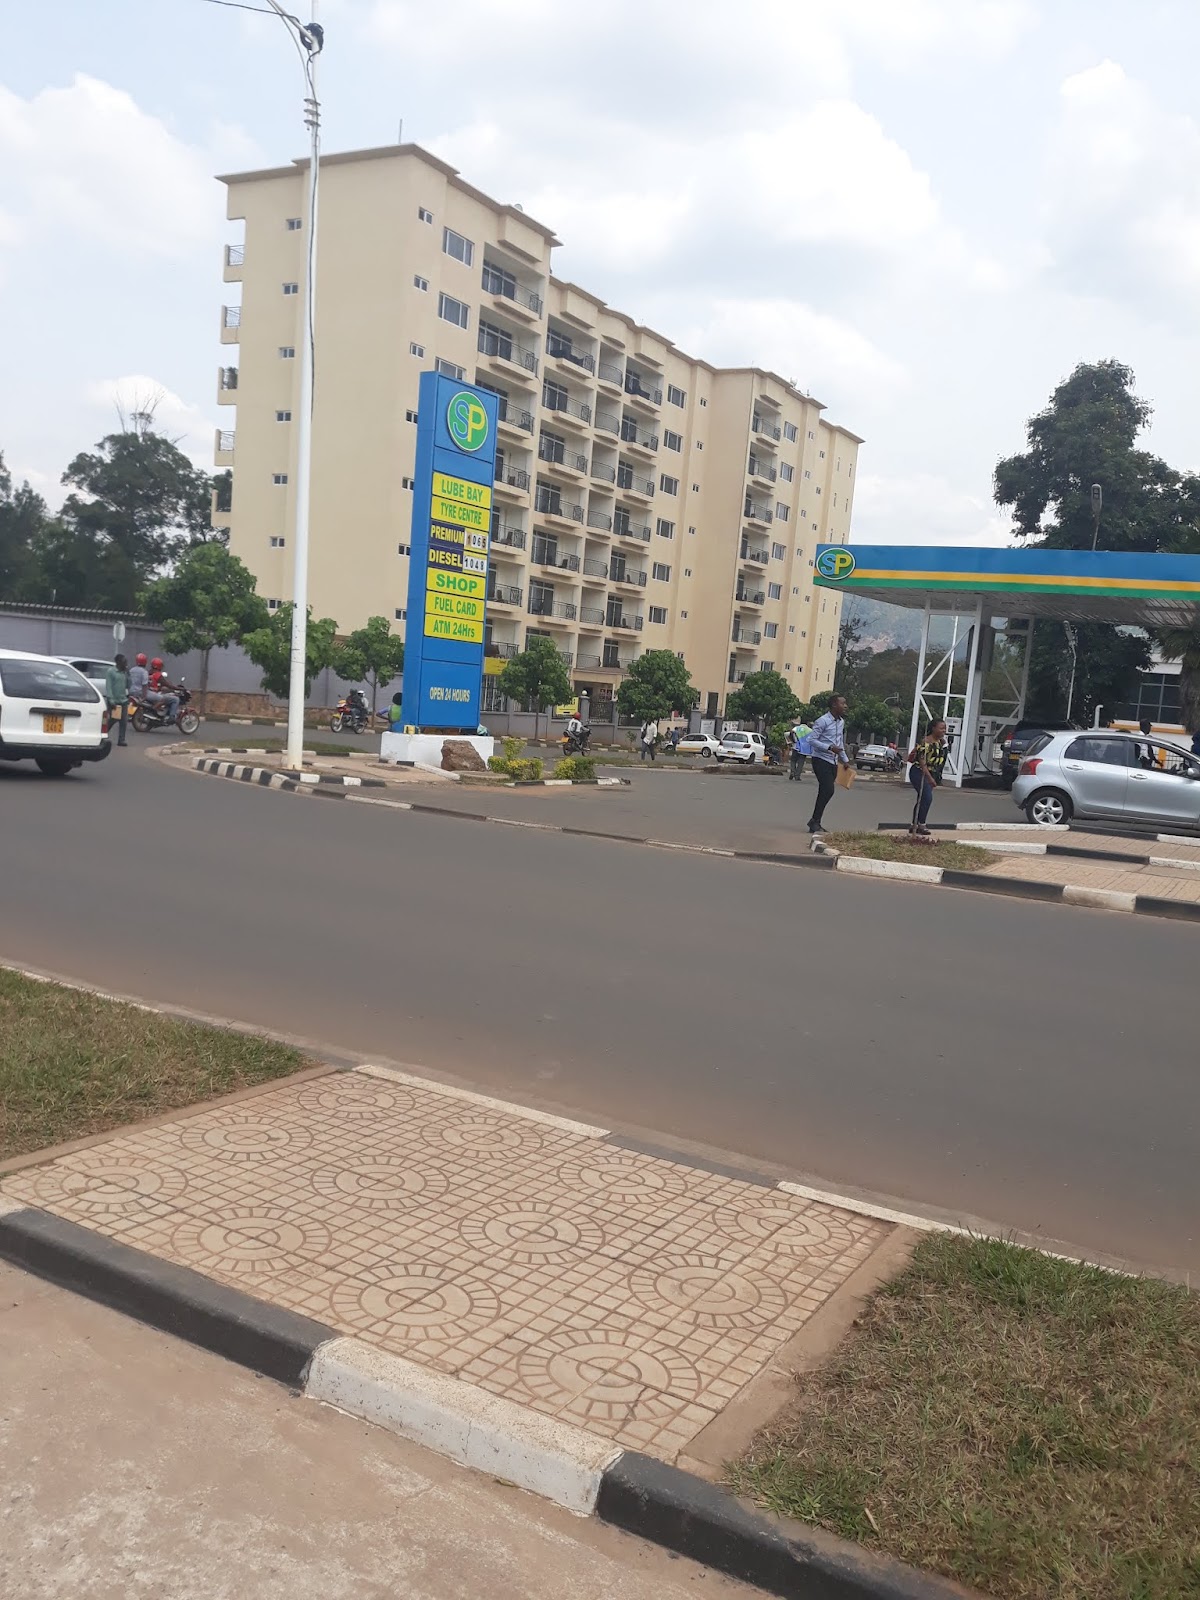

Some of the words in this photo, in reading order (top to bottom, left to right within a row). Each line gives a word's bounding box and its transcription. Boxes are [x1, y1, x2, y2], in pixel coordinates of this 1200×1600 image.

[453, 399, 486, 442] SP
[441, 479, 464, 498] LUBE
[467, 486, 483, 502] BAY
[441, 502, 456, 519] TYRE
[458, 507, 482, 525] CENTRE
[430, 525, 464, 544] PREMIUM
[467, 534, 486, 548] 1065
[429, 549, 463, 568] DIESEL
[464, 557, 485, 570] 1048
[820, 553, 852, 575] SP
[436, 573, 477, 593] SHOP
[434, 596, 454, 612] FUEL
[456, 600, 477, 616] CARD
[433, 619, 451, 634] ATM
[452, 622, 475, 638] 24Hrs
[429, 686, 445, 700] OPEN
[444, 688, 452, 701] 24
[451, 688, 471, 702] HOURS
